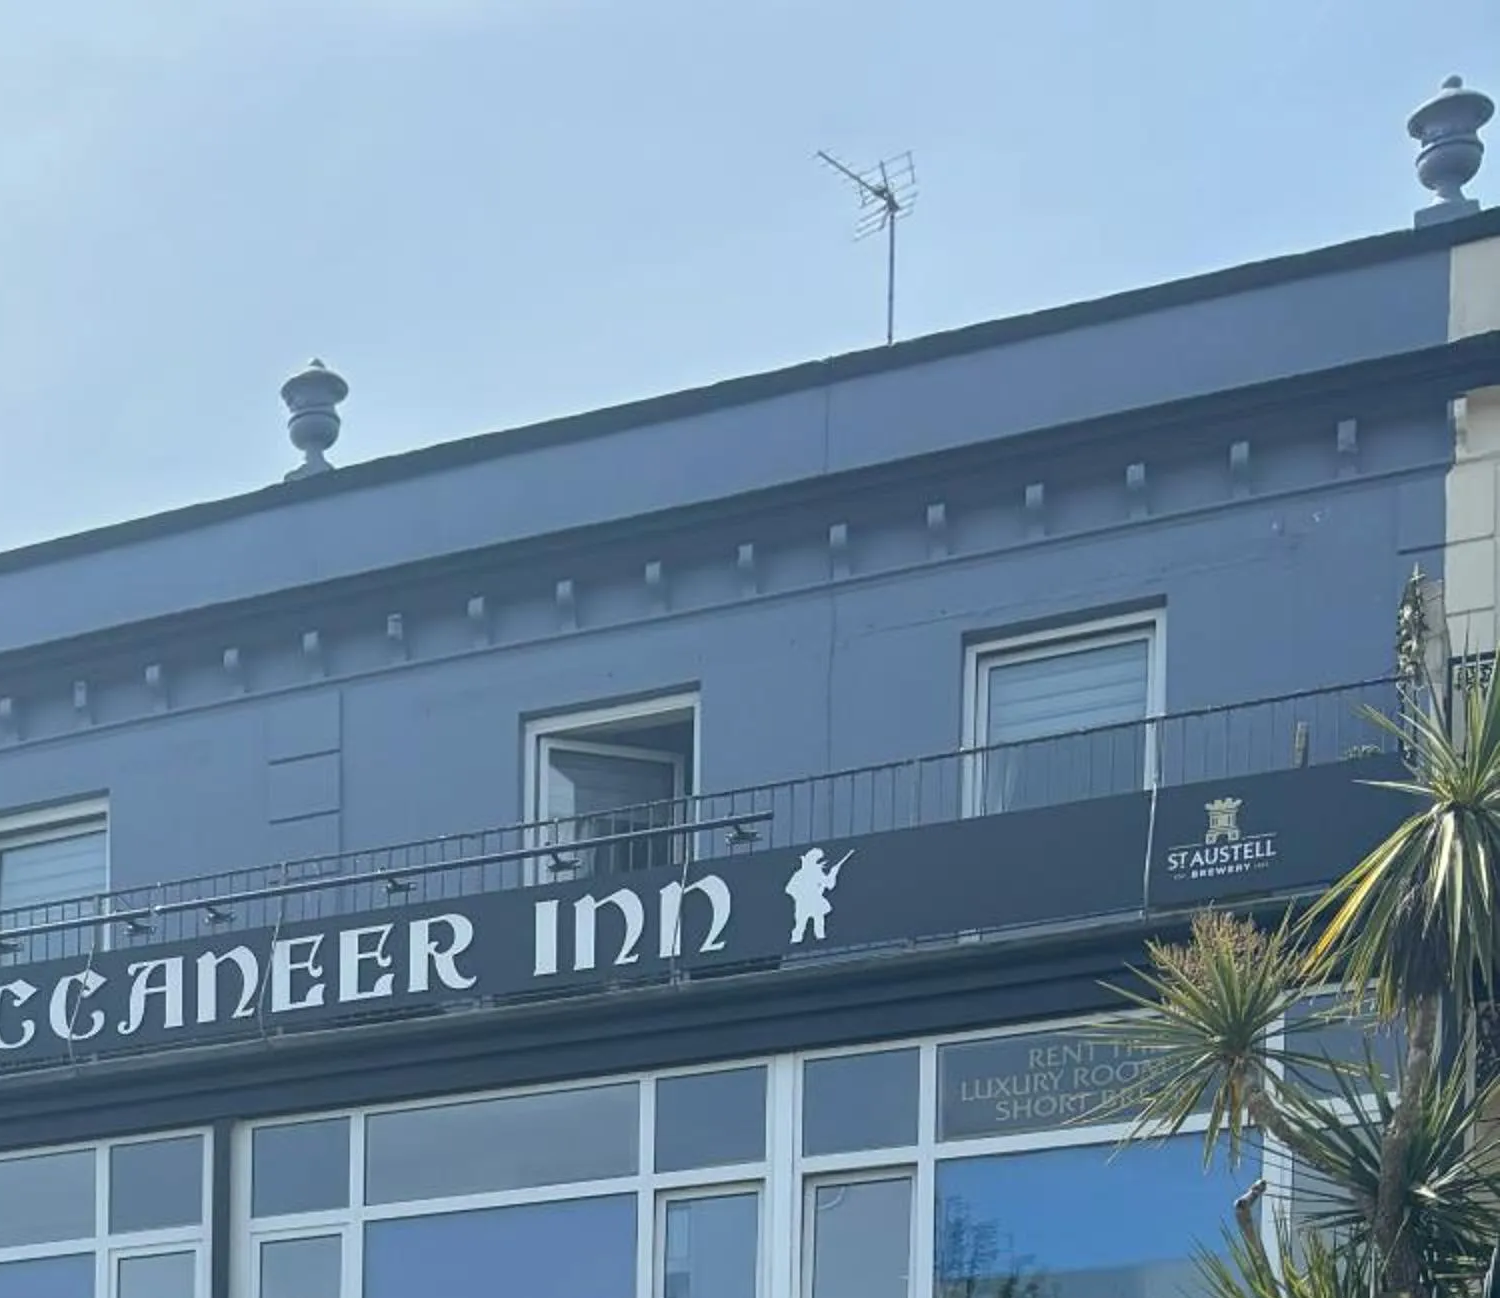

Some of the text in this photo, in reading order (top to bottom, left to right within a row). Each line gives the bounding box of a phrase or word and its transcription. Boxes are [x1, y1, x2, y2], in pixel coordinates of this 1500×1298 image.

[1190, 839, 1277, 867] AUSTELL
[1191, 862, 1251, 879] BREWERY
[533, 874, 732, 977] INN
[1029, 1040, 1096, 1069] RENT
[961, 1058, 1164, 1102] LUXURY ROO
[995, 1091, 1098, 1122] SHORT
